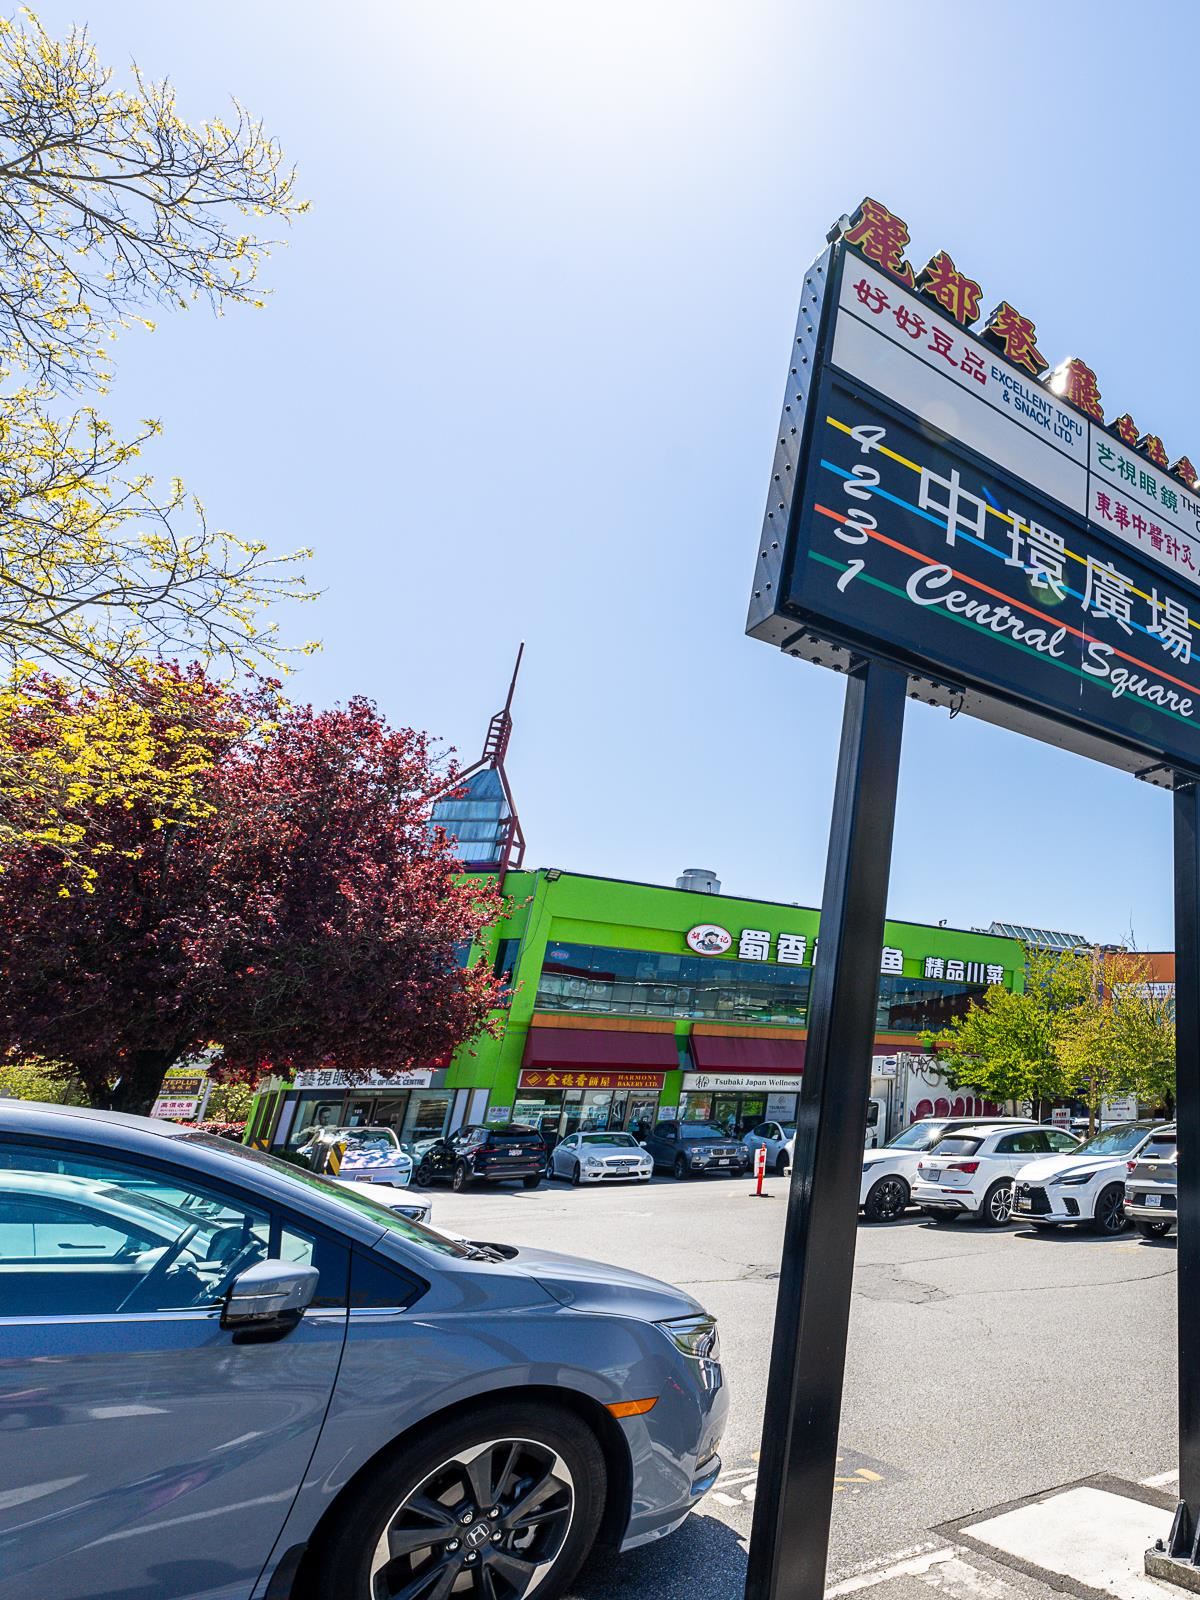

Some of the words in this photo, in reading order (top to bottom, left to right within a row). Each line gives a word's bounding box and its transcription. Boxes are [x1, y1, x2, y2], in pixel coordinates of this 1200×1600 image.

[844, 197, 1104, 421] 麗都餐廳
[853, 279, 987, 385] 好好豆品
[991, 365, 1053, 416] EXCELLENT
[1056, 409, 1082, 437] TOFU
[1002, 389, 1010, 404] &
[1014, 398, 1051, 431] SNACK
[1053, 422, 1074, 446] LTD.
[1096, 442, 1178, 514] 艺視眼鏡
[918, 466, 1194, 665] 中環廣場
[906, 564, 1065, 657] Central
[1081, 641, 1195, 717] Square
[924, 956, 1004, 984] 精品川菜
[402, 1078, 426, 1086] CENTRE
[714, 1078, 744, 1086] Tsubaki
[745, 1079, 767, 1087] Japan
[768, 1079, 800, 1087] Wellness
